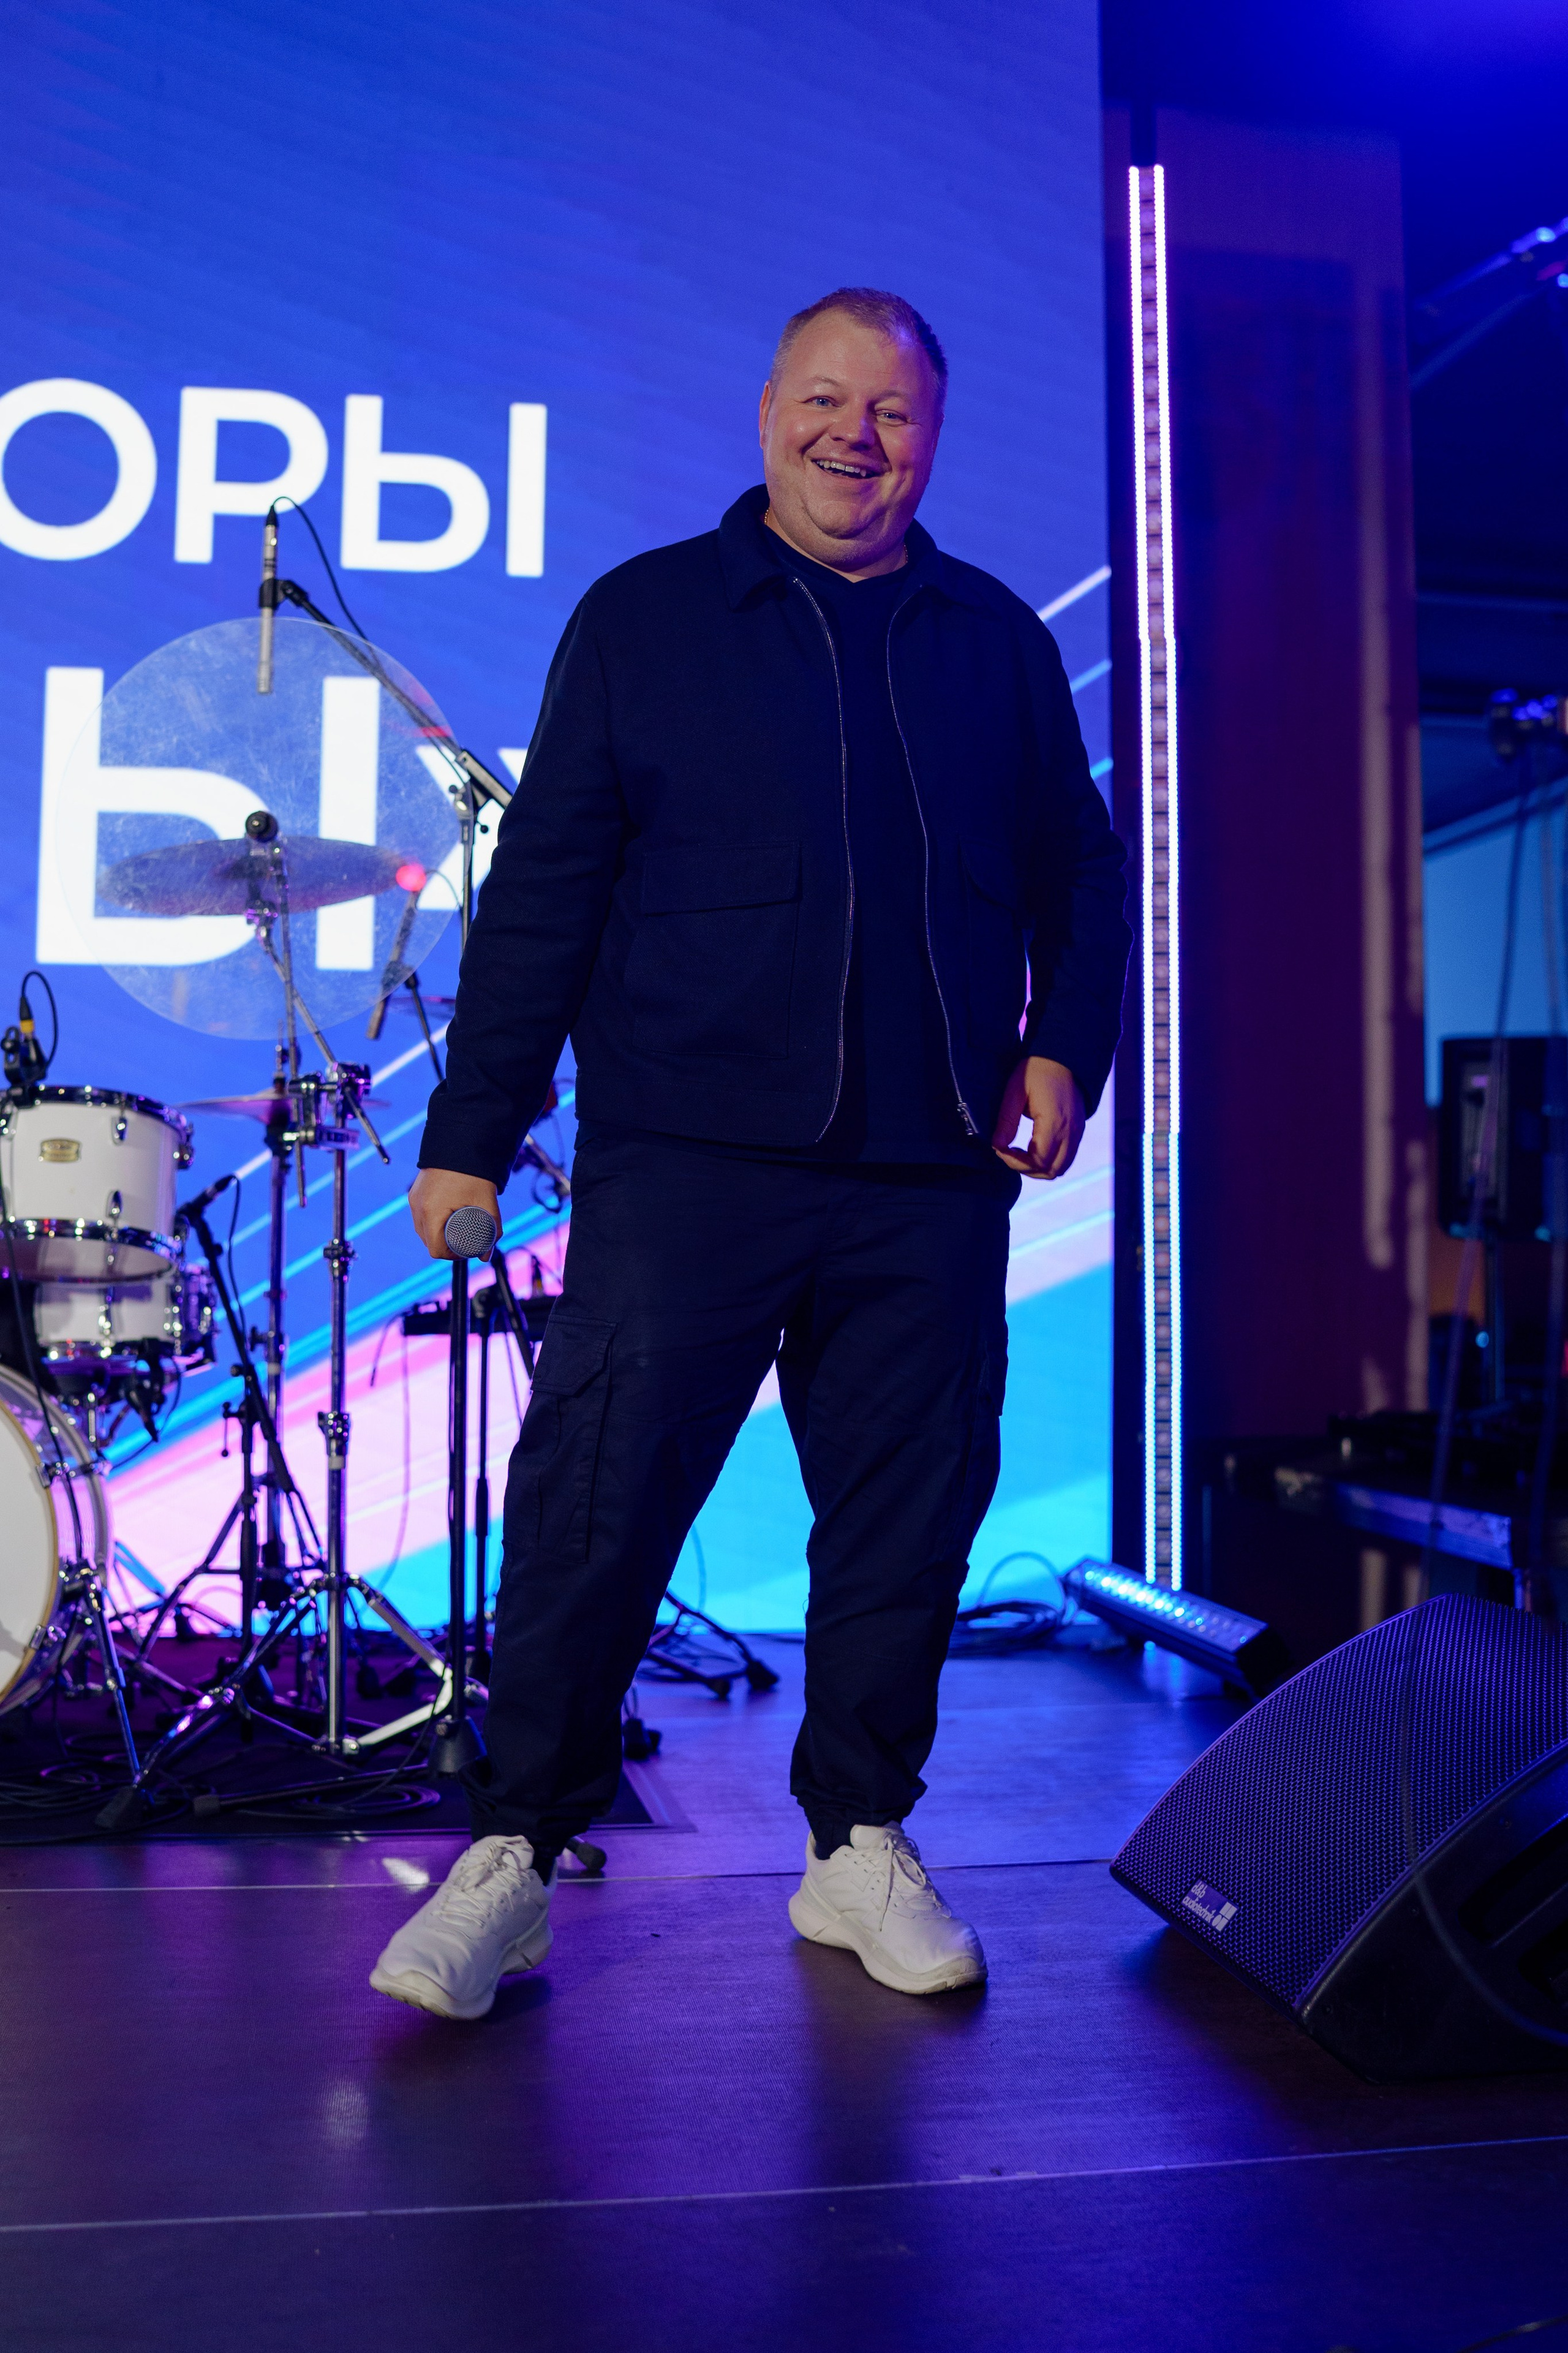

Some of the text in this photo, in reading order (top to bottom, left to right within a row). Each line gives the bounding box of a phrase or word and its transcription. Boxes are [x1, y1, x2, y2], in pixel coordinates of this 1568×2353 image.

[0, 378, 547, 577] ОРЫ
[1191, 1881, 1208, 1898] d&b
[1182, 1896, 1216, 1923] audiotechnik
